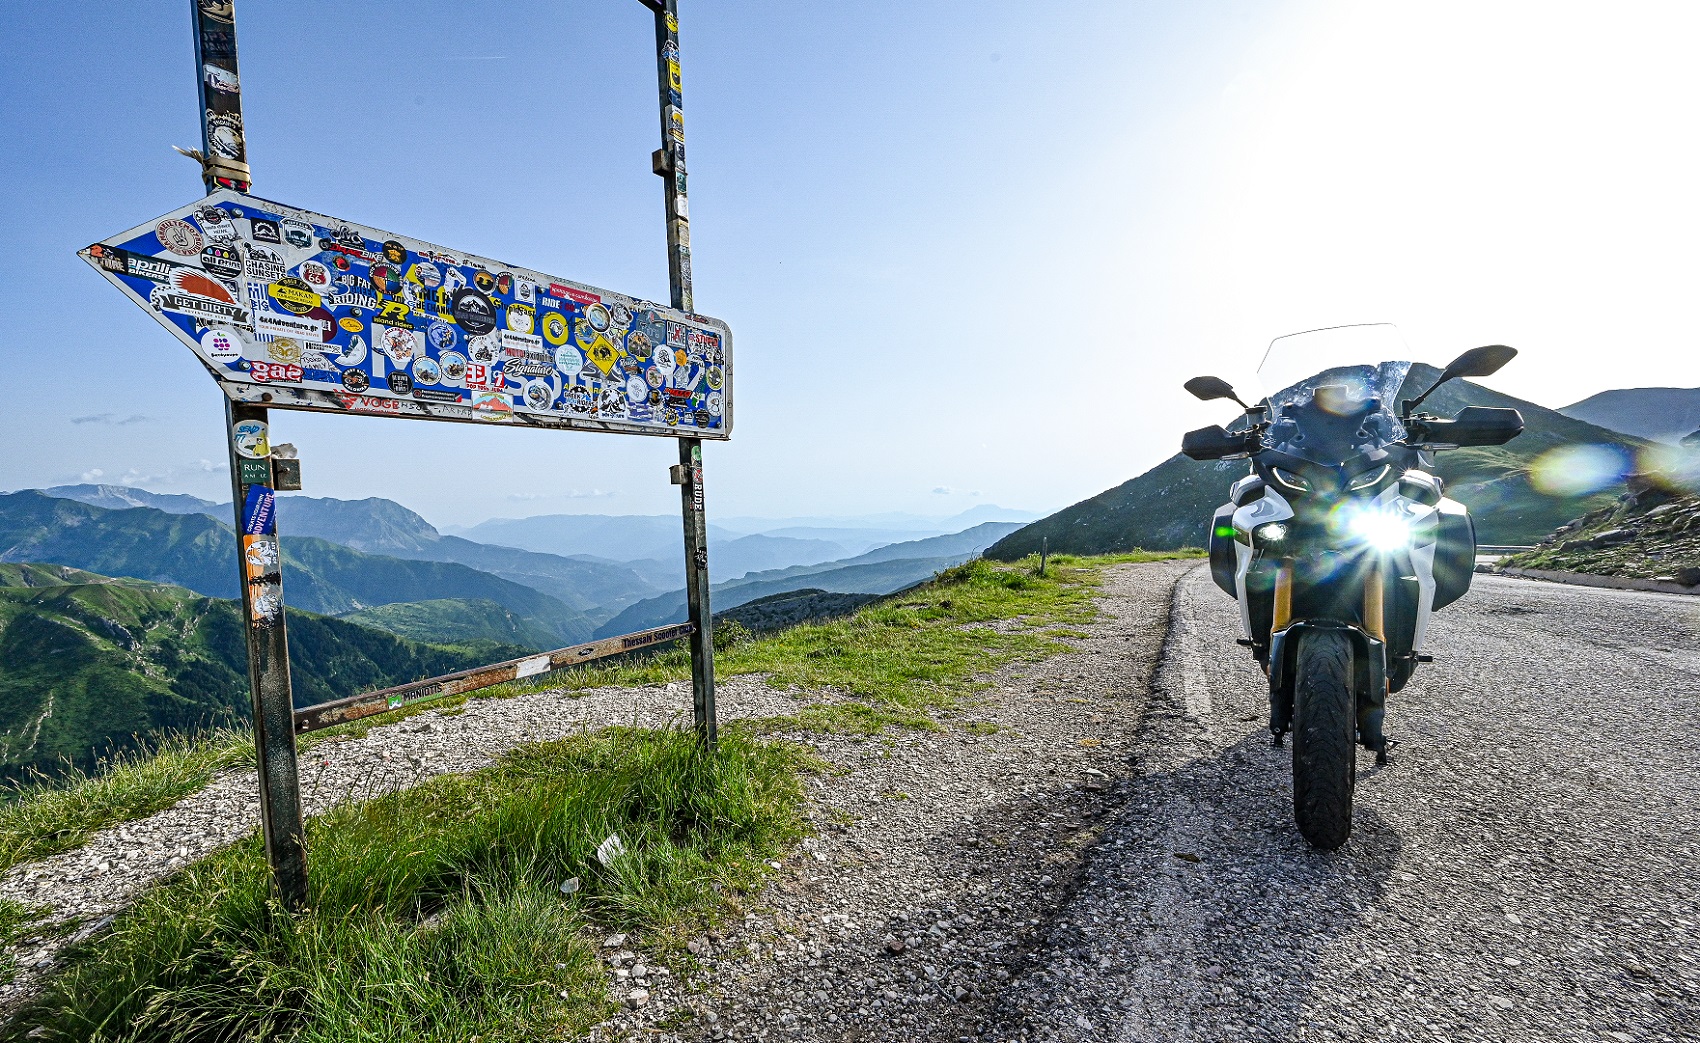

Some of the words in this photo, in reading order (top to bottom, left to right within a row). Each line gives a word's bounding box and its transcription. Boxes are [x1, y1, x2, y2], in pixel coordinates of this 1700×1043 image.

[128, 257, 170, 274] aprili
[246, 260, 285, 273] CHASING
[246, 267, 287, 279] SUNSETS
[308, 273, 321, 284] 66
[341, 274, 355, 287] BIG
[357, 276, 371, 289] FAT
[174, 296, 198, 309] GET
[200, 301, 237, 316] DIRTY
[334, 293, 377, 309] RIDING
[694, 483, 702, 511] RUDE
[402, 685, 443, 701] MANIOTIS
